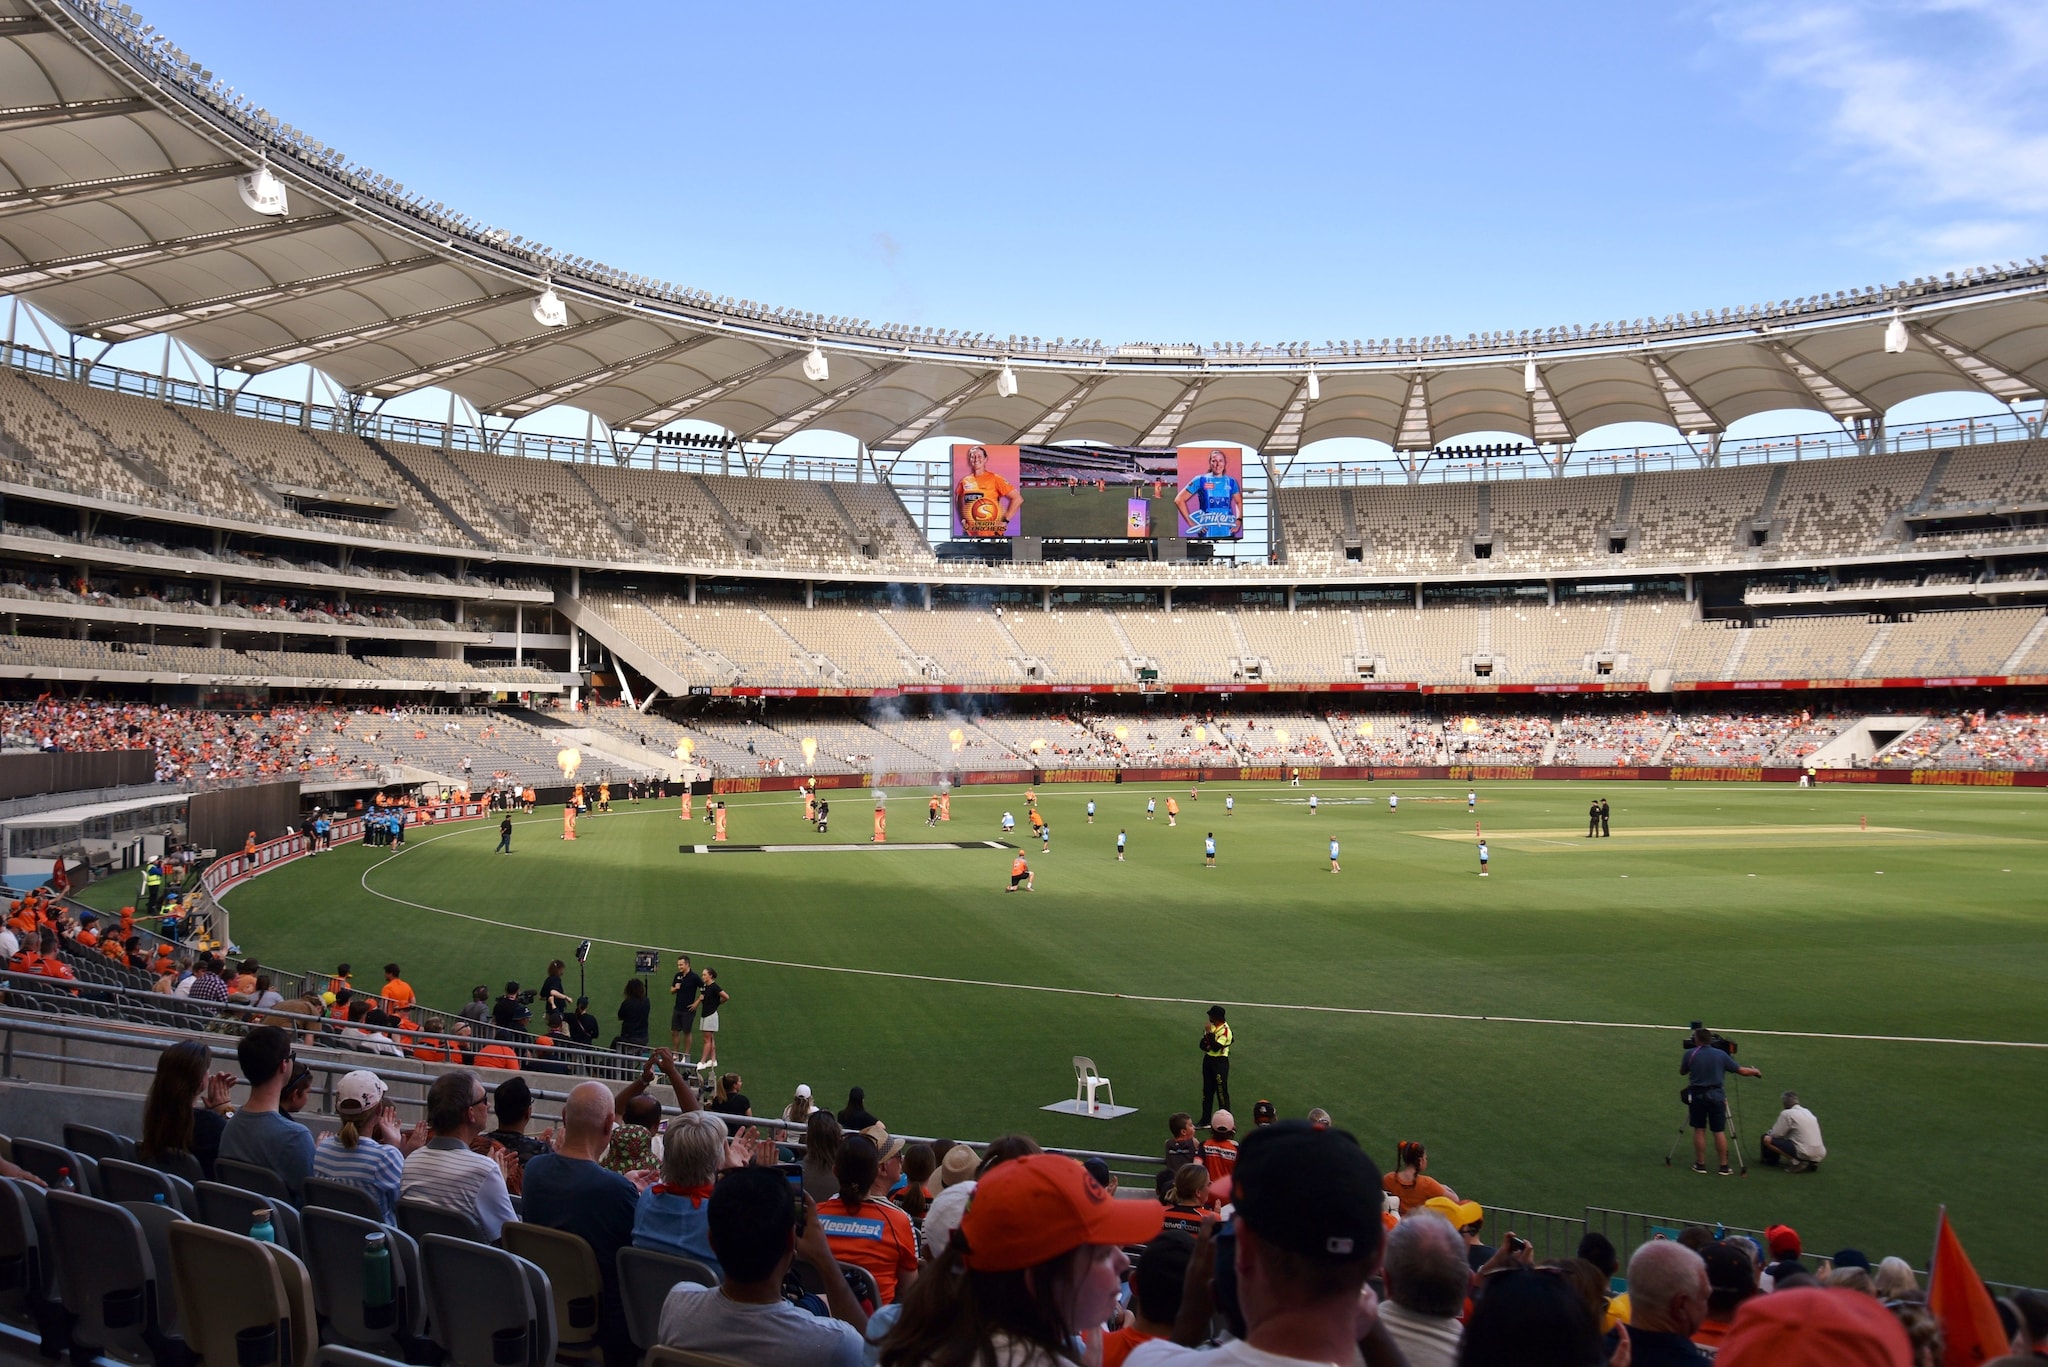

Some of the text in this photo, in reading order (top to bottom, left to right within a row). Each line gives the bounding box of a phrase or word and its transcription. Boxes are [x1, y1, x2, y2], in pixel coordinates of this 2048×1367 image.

[1185, 510, 1237, 534] Strikers
[1240, 768, 1321, 780] #MADETUGH
[1449, 766, 1535, 779] #MADETOUGH
[1670, 767, 1763, 781] #MADETOUGH
[1911, 770, 2016, 786] #MADETOUGH
[862, 773, 933, 787] #ADETOUGH
